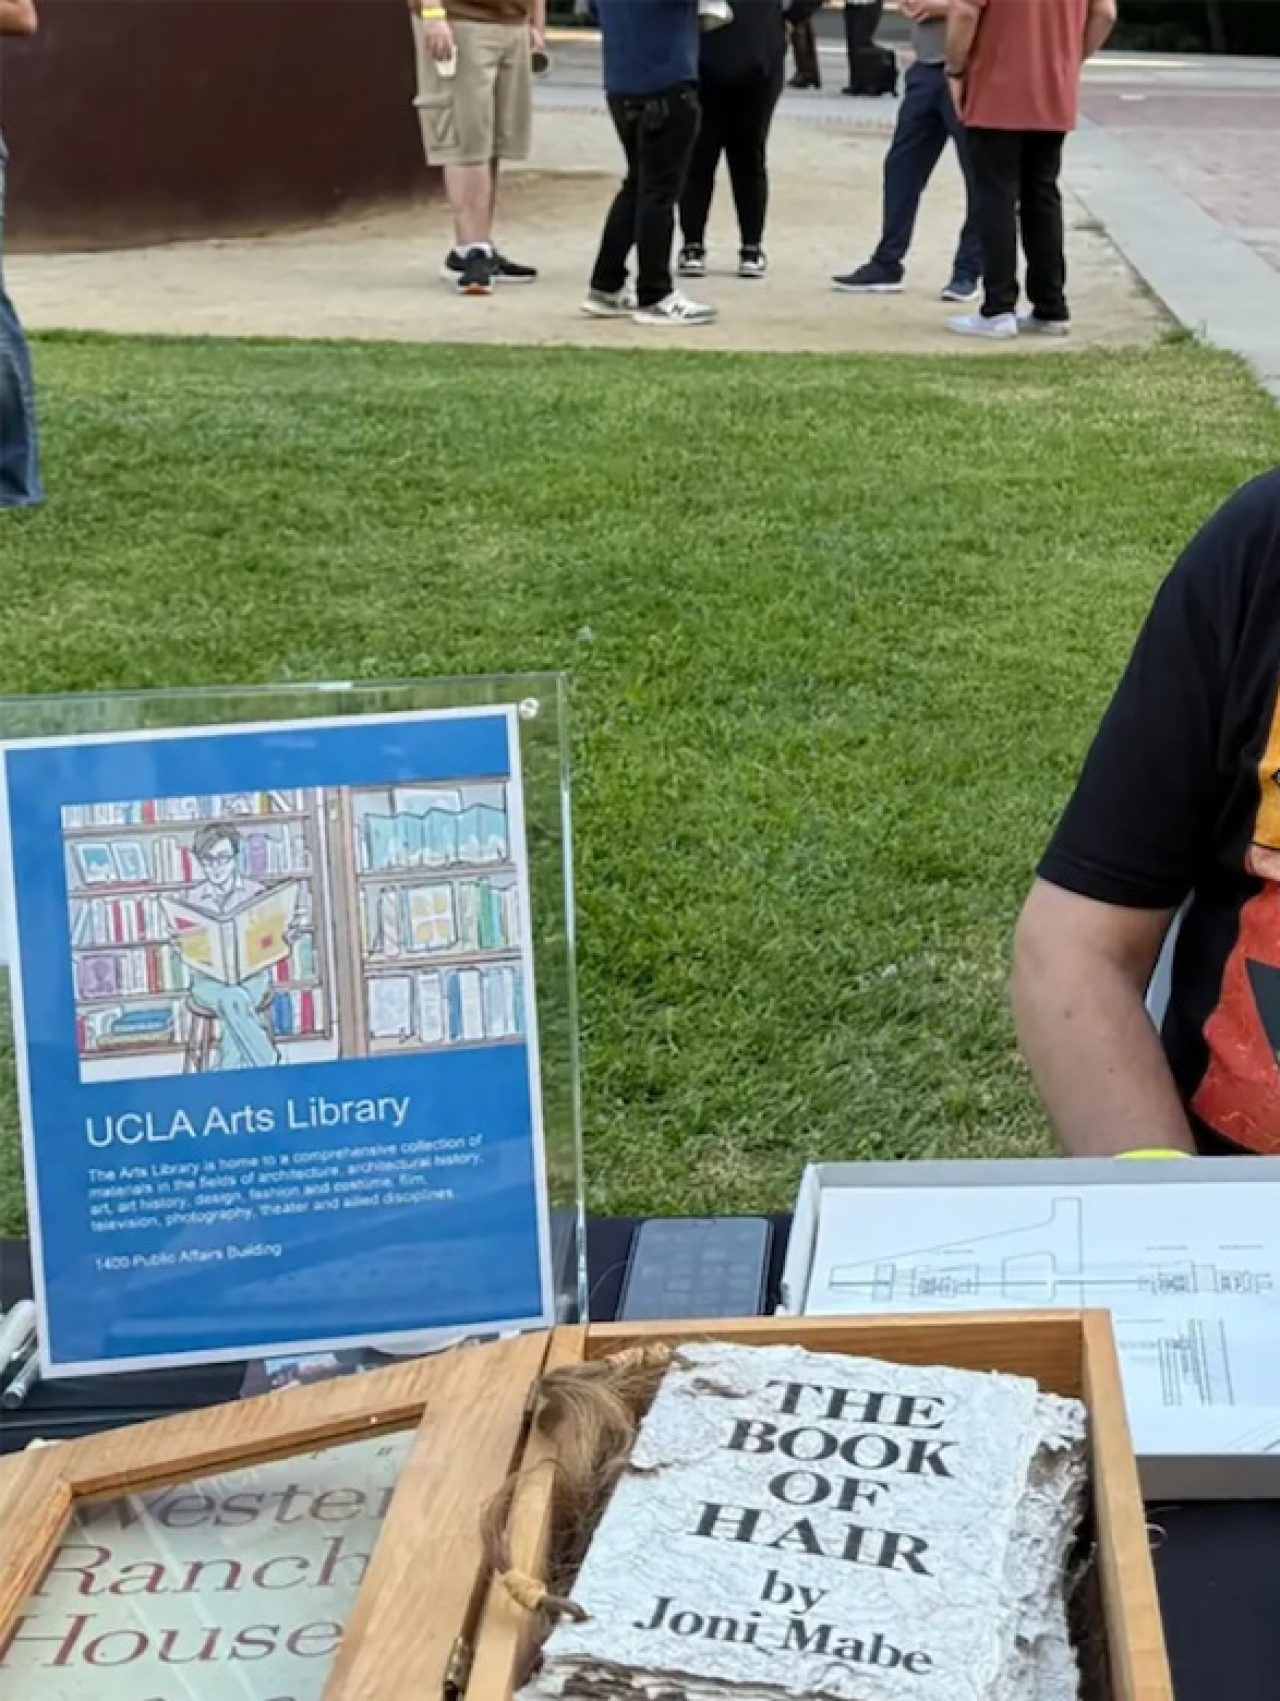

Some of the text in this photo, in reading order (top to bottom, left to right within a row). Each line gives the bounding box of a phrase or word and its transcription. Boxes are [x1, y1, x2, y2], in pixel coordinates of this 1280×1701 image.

[86, 1097, 410, 1147] UCLA Arts Library
[88, 1134, 482, 1182] The Arts Library is home to a comprehensive collection of
[88, 1184, 153, 1198] materials
[157, 1182, 170, 1192] in
[173, 1179, 195, 1190] the
[199, 1175, 236, 1188] fields
[240, 1172, 254, 1184] of
[348, 1159, 432, 1174] architectural
[117, 1200, 137, 1213] art
[249, 1186, 300, 1200] fashion
[303, 1182, 330, 1195] and
[259, 1202, 308, 1217] theater
[313, 1198, 339, 1211] and
[343, 1194, 379, 1209] allied
[96, 1243, 281, 1270] 1400 Public Affairs Building
[765, 1379, 945, 1429] THE
[720, 1417, 959, 1478] BOOK
[768, 1469, 890, 1512] OF
[687, 1501, 934, 1577] HAIR
[31, 1537, 370, 1597] Ranch
[760, 1569, 829, 1615] by
[0, 1614, 343, 1668] House
[633, 1595, 933, 1675] Joni Mabe
